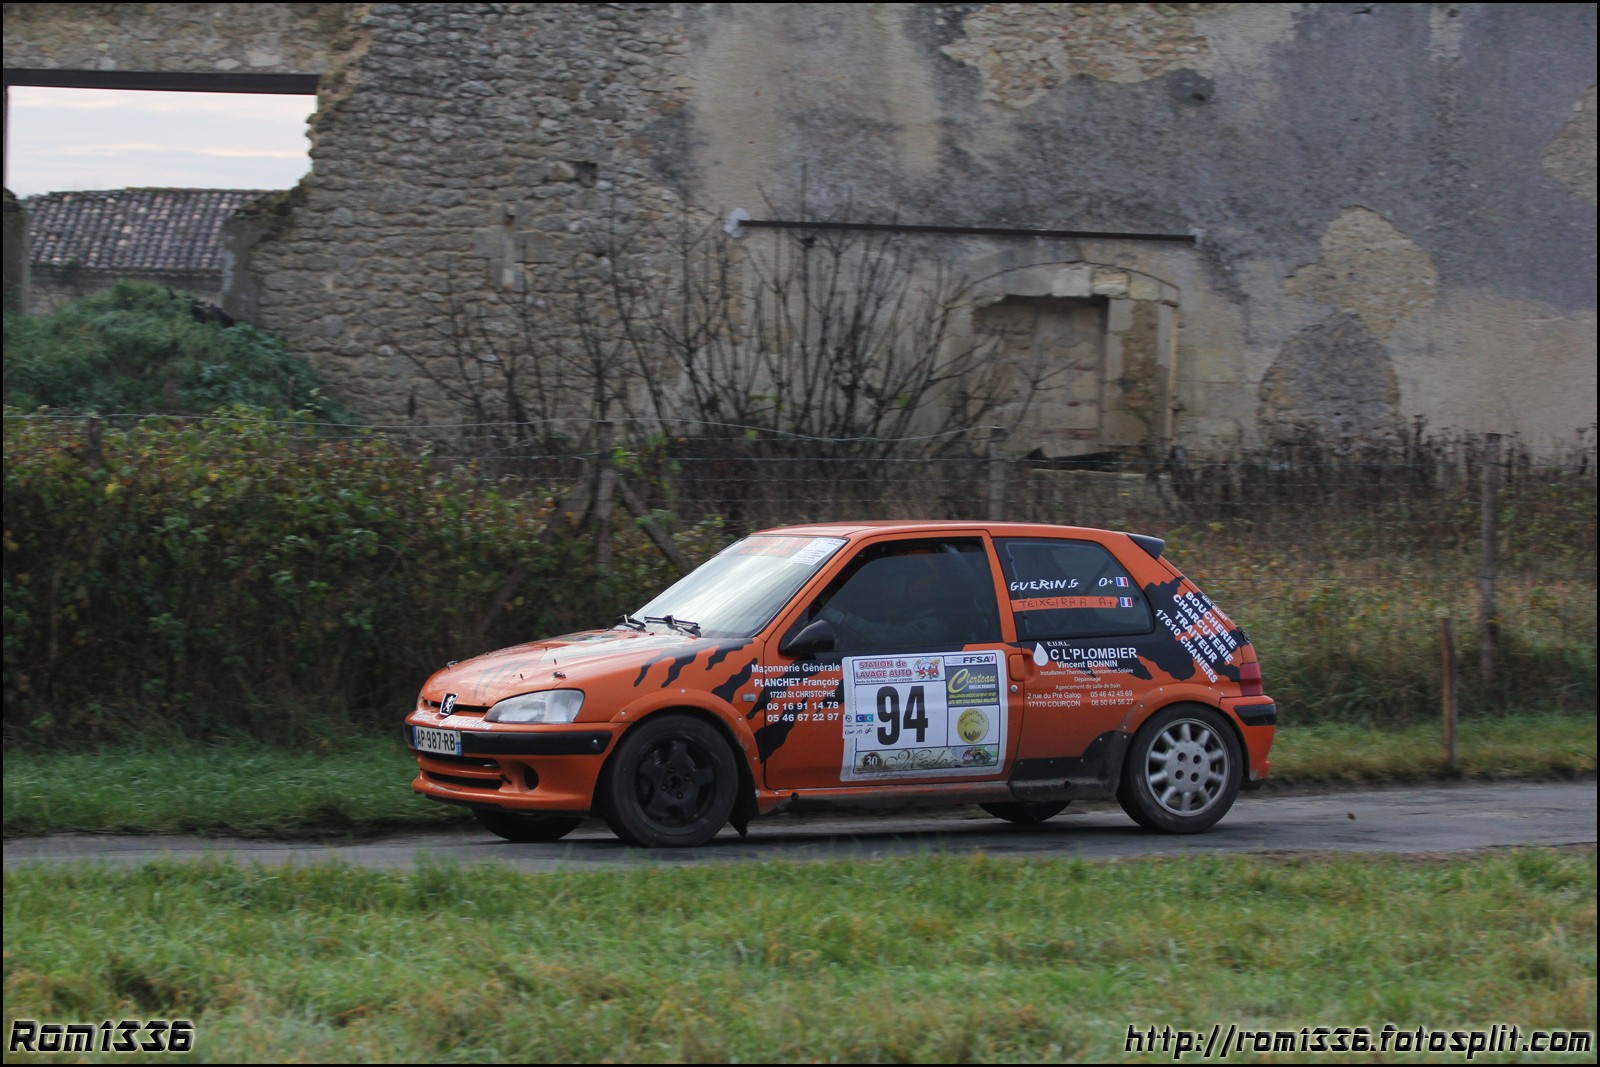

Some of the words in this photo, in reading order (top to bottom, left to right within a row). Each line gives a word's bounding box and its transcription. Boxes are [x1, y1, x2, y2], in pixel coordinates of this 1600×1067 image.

[1010, 579, 1079, 591] GUERIN.G
[1185, 591, 1238, 649] BOUCHERIE
[1173, 594, 1233, 664] CHARCUTERIE
[1174, 611, 1218, 663] TRAITEUR
[1156, 609, 1181, 636] 17610
[1181, 636, 1217, 683] CHANIERS
[1050, 649, 1059, 660] C
[1063, 648, 1137, 660] L'PLOMBIER
[752, 664, 800, 674] Maçonnerie
[802, 663, 840, 672] Générale
[859, 660, 894, 669] STATION
[856, 670, 887, 679] LAVAGE
[754, 678, 800, 687] PLANCHET
[802, 678, 840, 687] François
[876, 686, 928, 745] 94
[417, 729, 456, 751] AP-987-RB
[866, 755, 878, 766] 30
